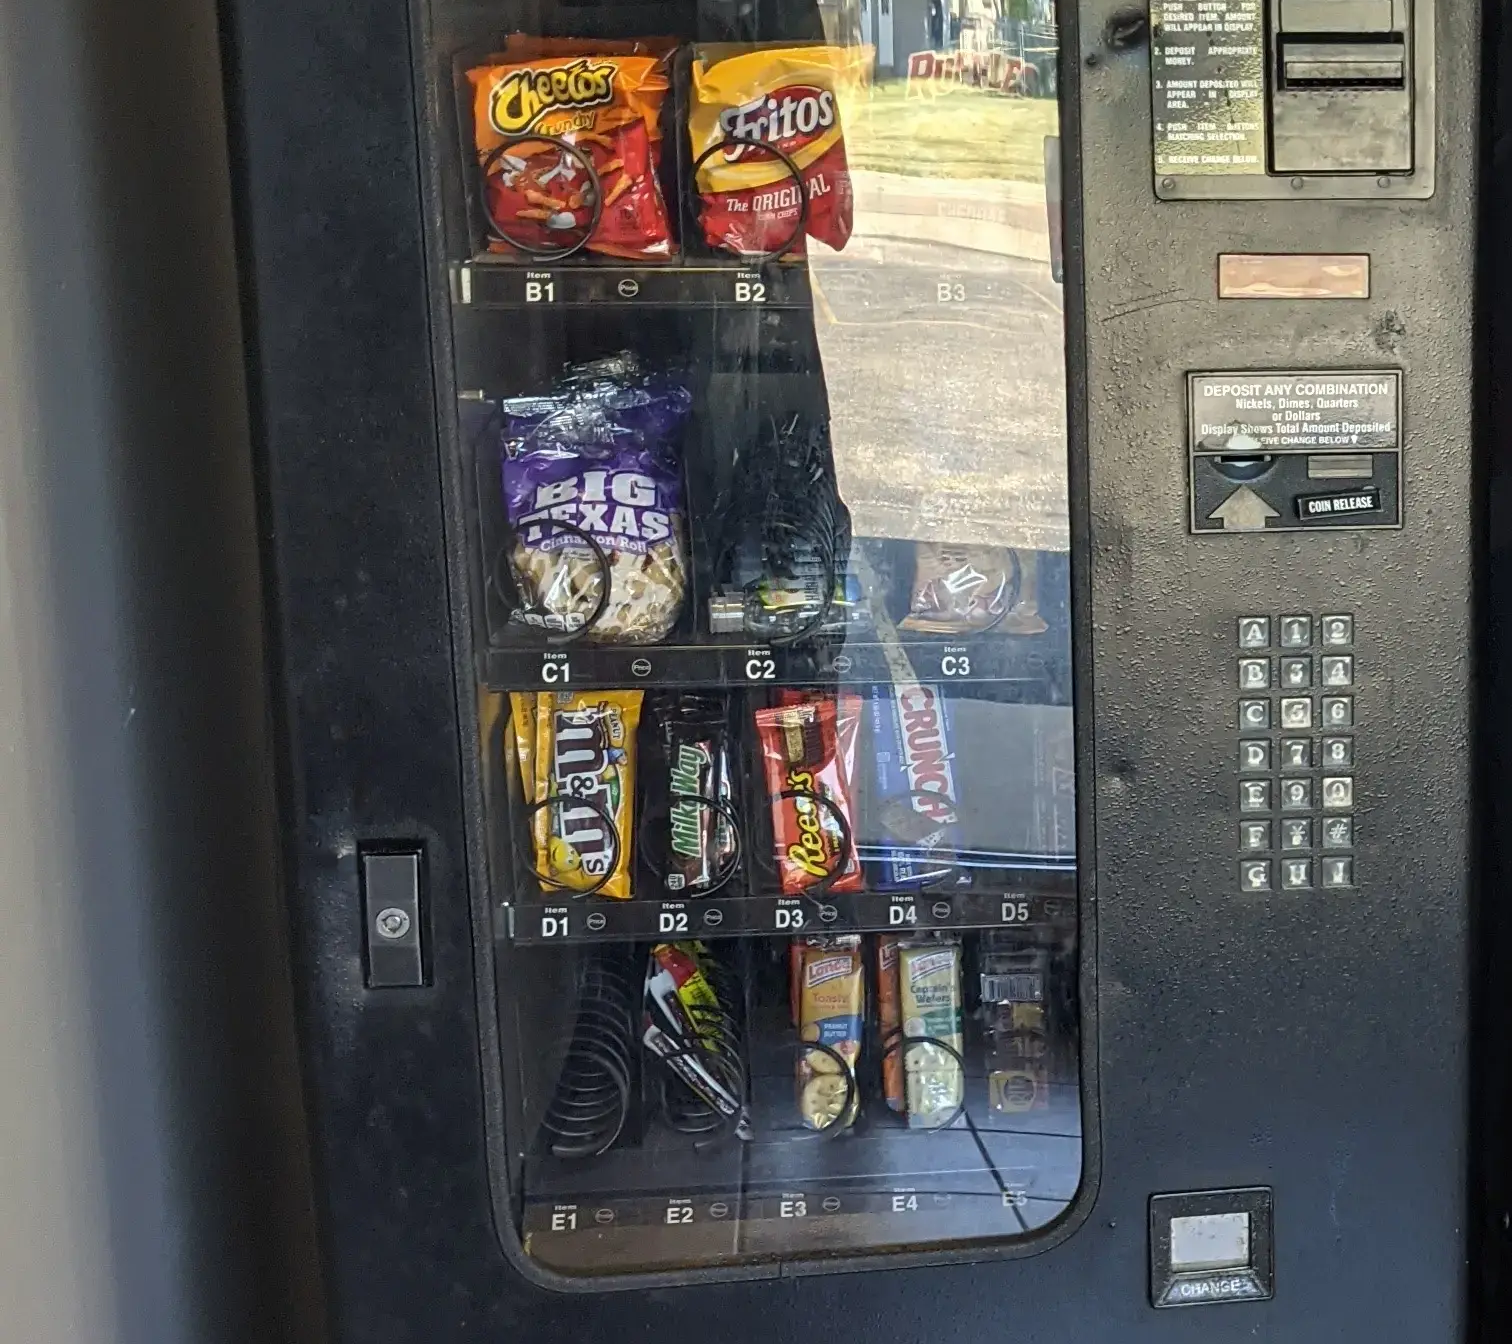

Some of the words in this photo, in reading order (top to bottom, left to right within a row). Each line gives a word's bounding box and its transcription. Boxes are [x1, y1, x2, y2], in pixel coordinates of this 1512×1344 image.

[1163, 3, 1183, 11] PUSH
[1198, 3, 1226, 11] BUTTON
[1163, 12, 1194, 21] DESIRED
[1224, 12, 1257, 21] AMOUNT
[1164, 23, 1181, 32] WILL
[1183, 23, 1213, 32] APPEAR
[1214, 23, 1222, 32] IN
[1165, 46, 1196, 55] DEPOSIT
[1165, 57, 1195, 65] MONEY.
[1166, 80, 1197, 89] AMOUNT
[1199, 80, 1239, 89] DEPOSITED
[493, 60, 615, 133] Cheetos
[1166, 90, 1196, 99] APPEAR
[1208, 90, 1217, 99] IN
[720, 91, 834, 161] Fritos
[726, 199, 748, 212] The
[752, 174, 831, 211] ORIGIAL
[525, 282, 554, 302] B1
[735, 282, 766, 302] B2
[937, 282, 965, 302] B3
[1203, 385, 1261, 397] DEPOSIT
[1264, 384, 1293, 396] ANY
[1295, 383, 1388, 395] COMBINATION
[1235, 398, 1276, 410] Nickels,
[1278, 398, 1314, 410] Dimes,
[1316, 397, 1359, 408] Quarters
[1272, 412, 1283, 421] or
[1285, 411, 1321, 421] Dollars
[1201, 424, 1238, 437] Display
[1240, 423, 1273, 434] Shows
[1275, 423, 1299, 433] Total
[1302, 422, 1339, 433] Amount
[1342, 422, 1391, 433] Deposited
[1281, 436, 1317, 445] CHANGE
[1319, 435, 1350, 444] BELOW
[535, 470, 656, 509] BIG
[1308, 499, 1331, 513] COIN
[1333, 496, 1374, 511] RELEASE
[519, 503, 670, 542] TEXAS
[619, 538, 648, 553] Roll
[1247, 623, 1263, 640] A
[1291, 623, 1301, 639] 1
[1331, 622, 1345, 638] 2
[542, 662, 570, 683] C1
[746, 659, 776, 679] C2
[941, 656, 970, 676] C3
[1248, 664, 1263, 681] B
[1331, 662, 1344, 678] 4
[1247, 705, 1264, 722] C
[1290, 705, 1303, 721] 5
[1332, 704, 1344, 719] 6
[610, 708, 621, 740] PEANUT
[901, 686, 957, 824] CRUNCH
[1247, 746, 1264, 762] D
[1290, 745, 1303, 760] 7
[1332, 743, 1345, 759] 8
[670, 744, 707, 802] Way
[1246, 785, 1264, 802] E
[1291, 784, 1304, 800] 9
[671, 798, 707, 858] Milky
[1248, 826, 1264, 843] F
[1248, 866, 1266, 883] G
[775, 909, 804, 928] D3
[889, 905, 917, 925] D4
[1001, 902, 1028, 922] D5
[542, 917, 569, 937] D1
[659, 913, 688, 932] D2
[892, 1196, 918, 1212] E4
[1002, 1190, 1028, 1207] E5
[666, 1207, 693, 1224] E2
[780, 1201, 807, 1218] E3
[551, 1213, 577, 1231] E1
[1181, 1279, 1240, 1296] CHANGE
